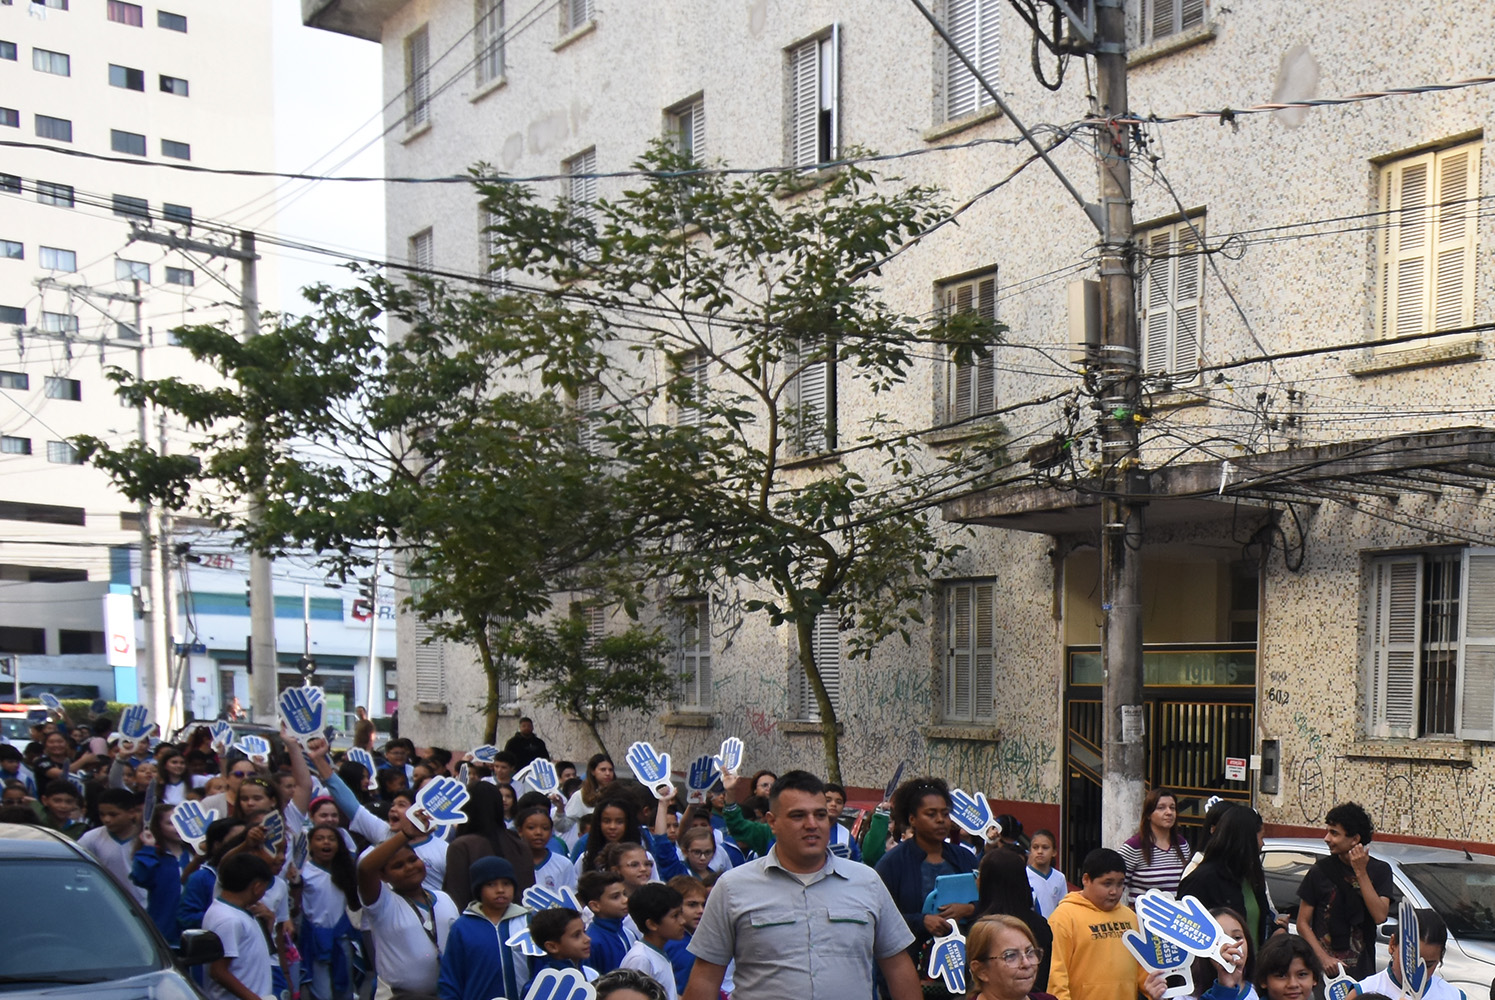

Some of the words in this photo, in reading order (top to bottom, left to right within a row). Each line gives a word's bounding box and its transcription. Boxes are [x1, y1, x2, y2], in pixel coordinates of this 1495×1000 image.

[202, 554, 234, 569] 24h
[1268, 687, 1290, 707] 602
[1172, 918, 1212, 943] RESPEITE
[1176, 913, 1201, 930] PARE!
[946, 943, 959, 969] RESPEITE
[1150, 933, 1164, 965] ATENÇÃ
